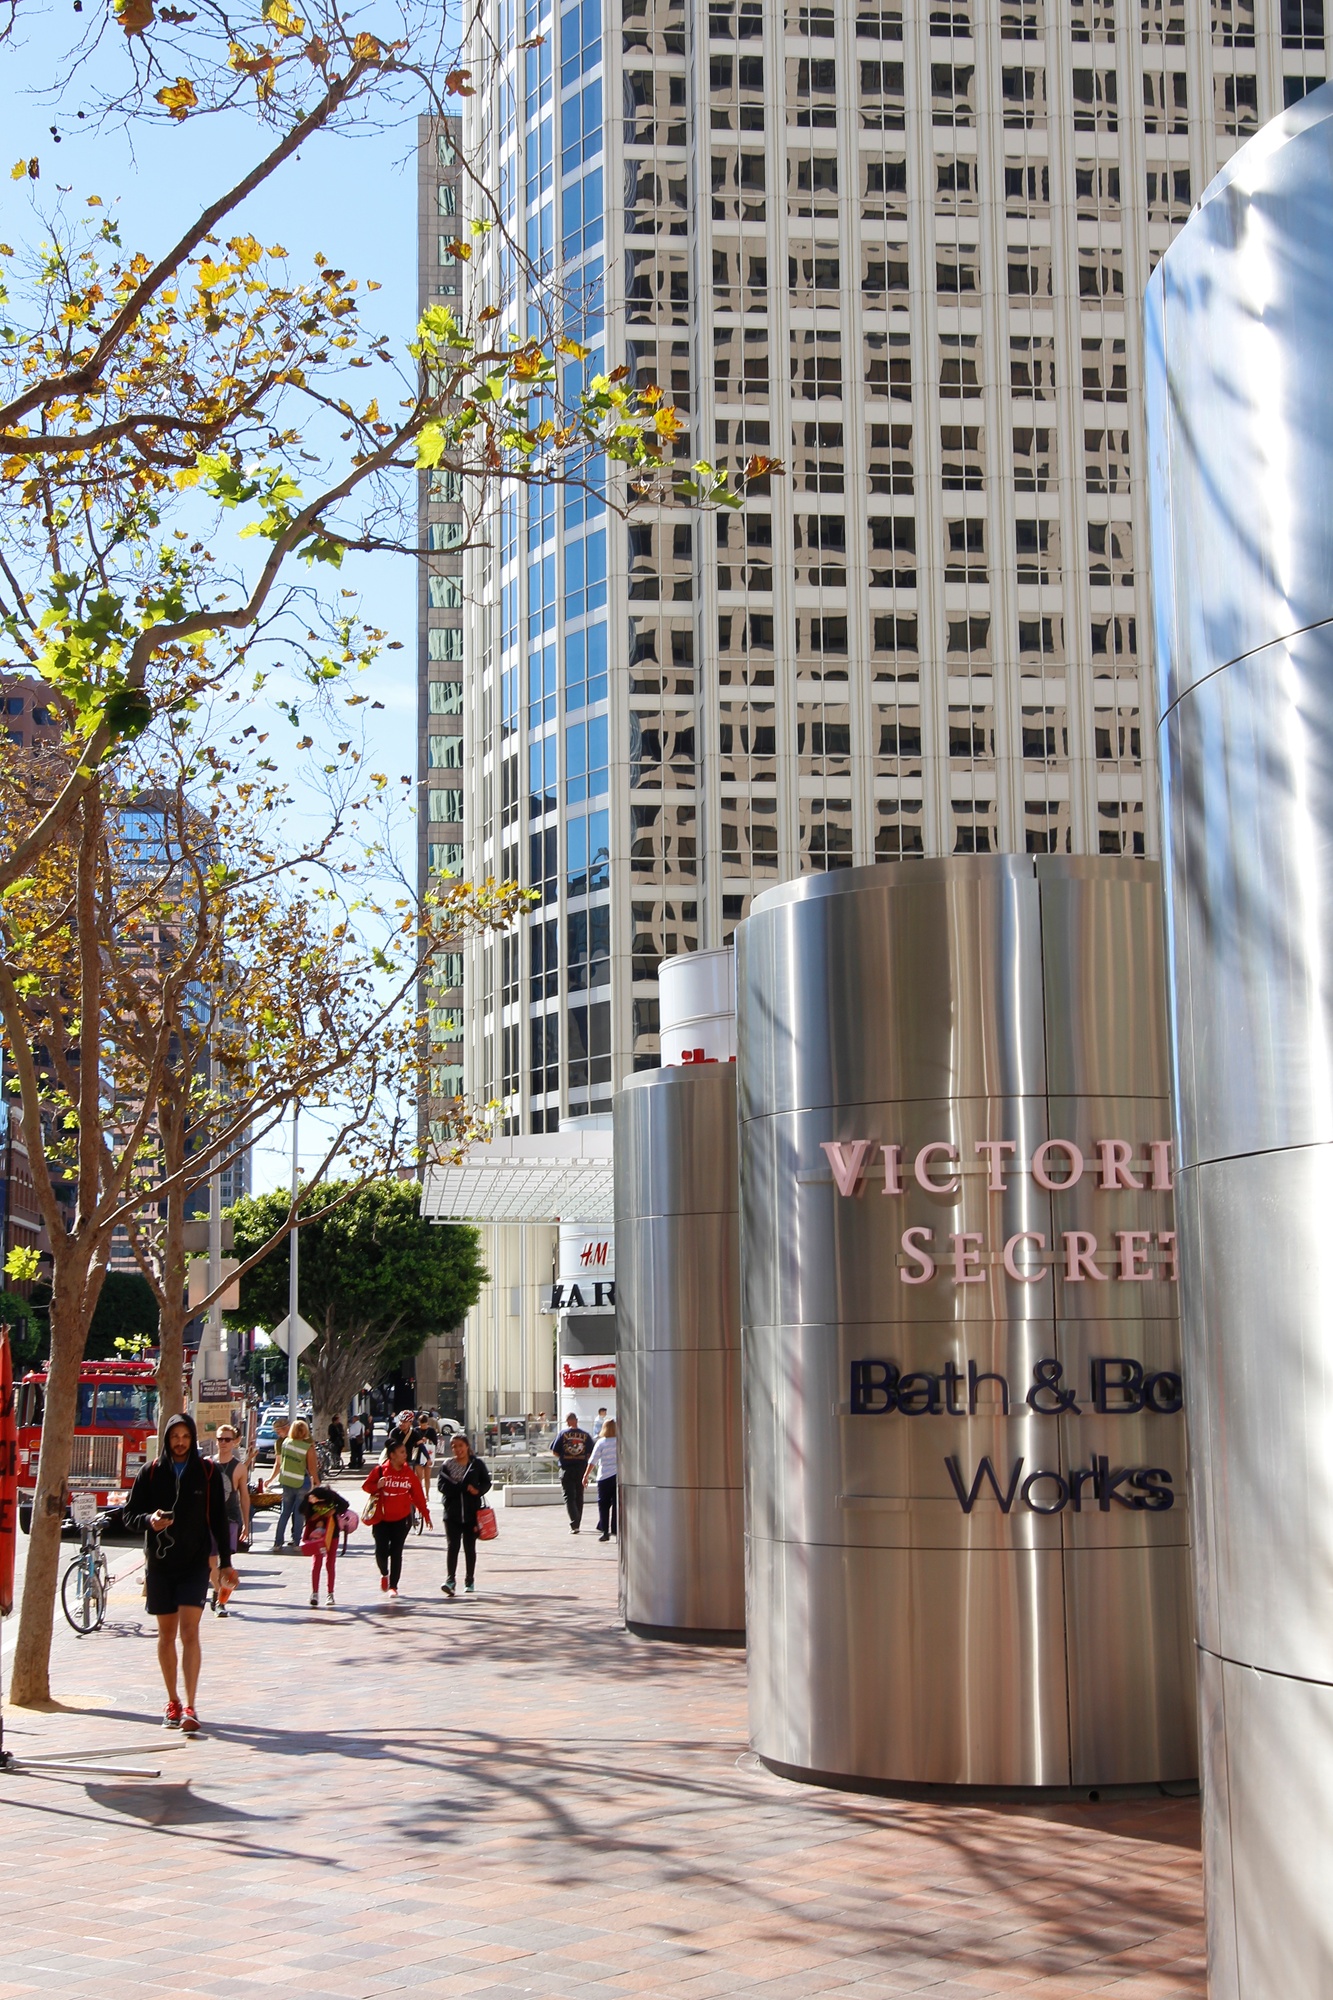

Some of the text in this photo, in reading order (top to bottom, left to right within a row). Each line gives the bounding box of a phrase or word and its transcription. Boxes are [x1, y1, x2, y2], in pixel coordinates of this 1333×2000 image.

[580, 1241, 608, 1267] H&M
[850, 1359, 1010, 1416] Bath
[1026, 1358, 1082, 1416] &
[384, 1478, 412, 1489] riends
[944, 1455, 1174, 1515] Works
